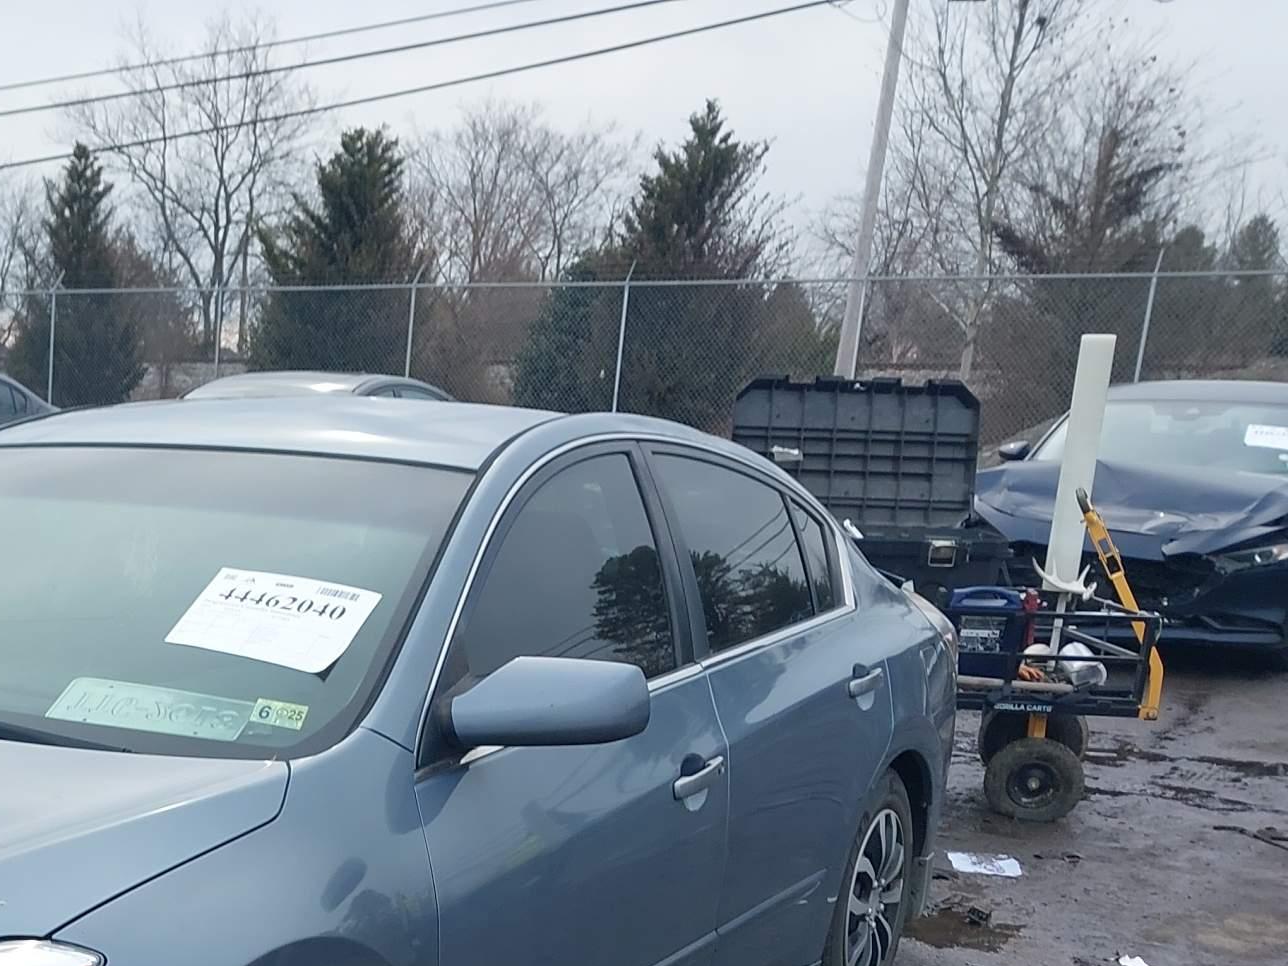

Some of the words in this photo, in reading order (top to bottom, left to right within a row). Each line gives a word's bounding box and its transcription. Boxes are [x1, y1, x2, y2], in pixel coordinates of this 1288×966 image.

[219, 587, 346, 620] 44462040
[259, 705, 272, 720] 6
[288, 709, 305, 721] 25
